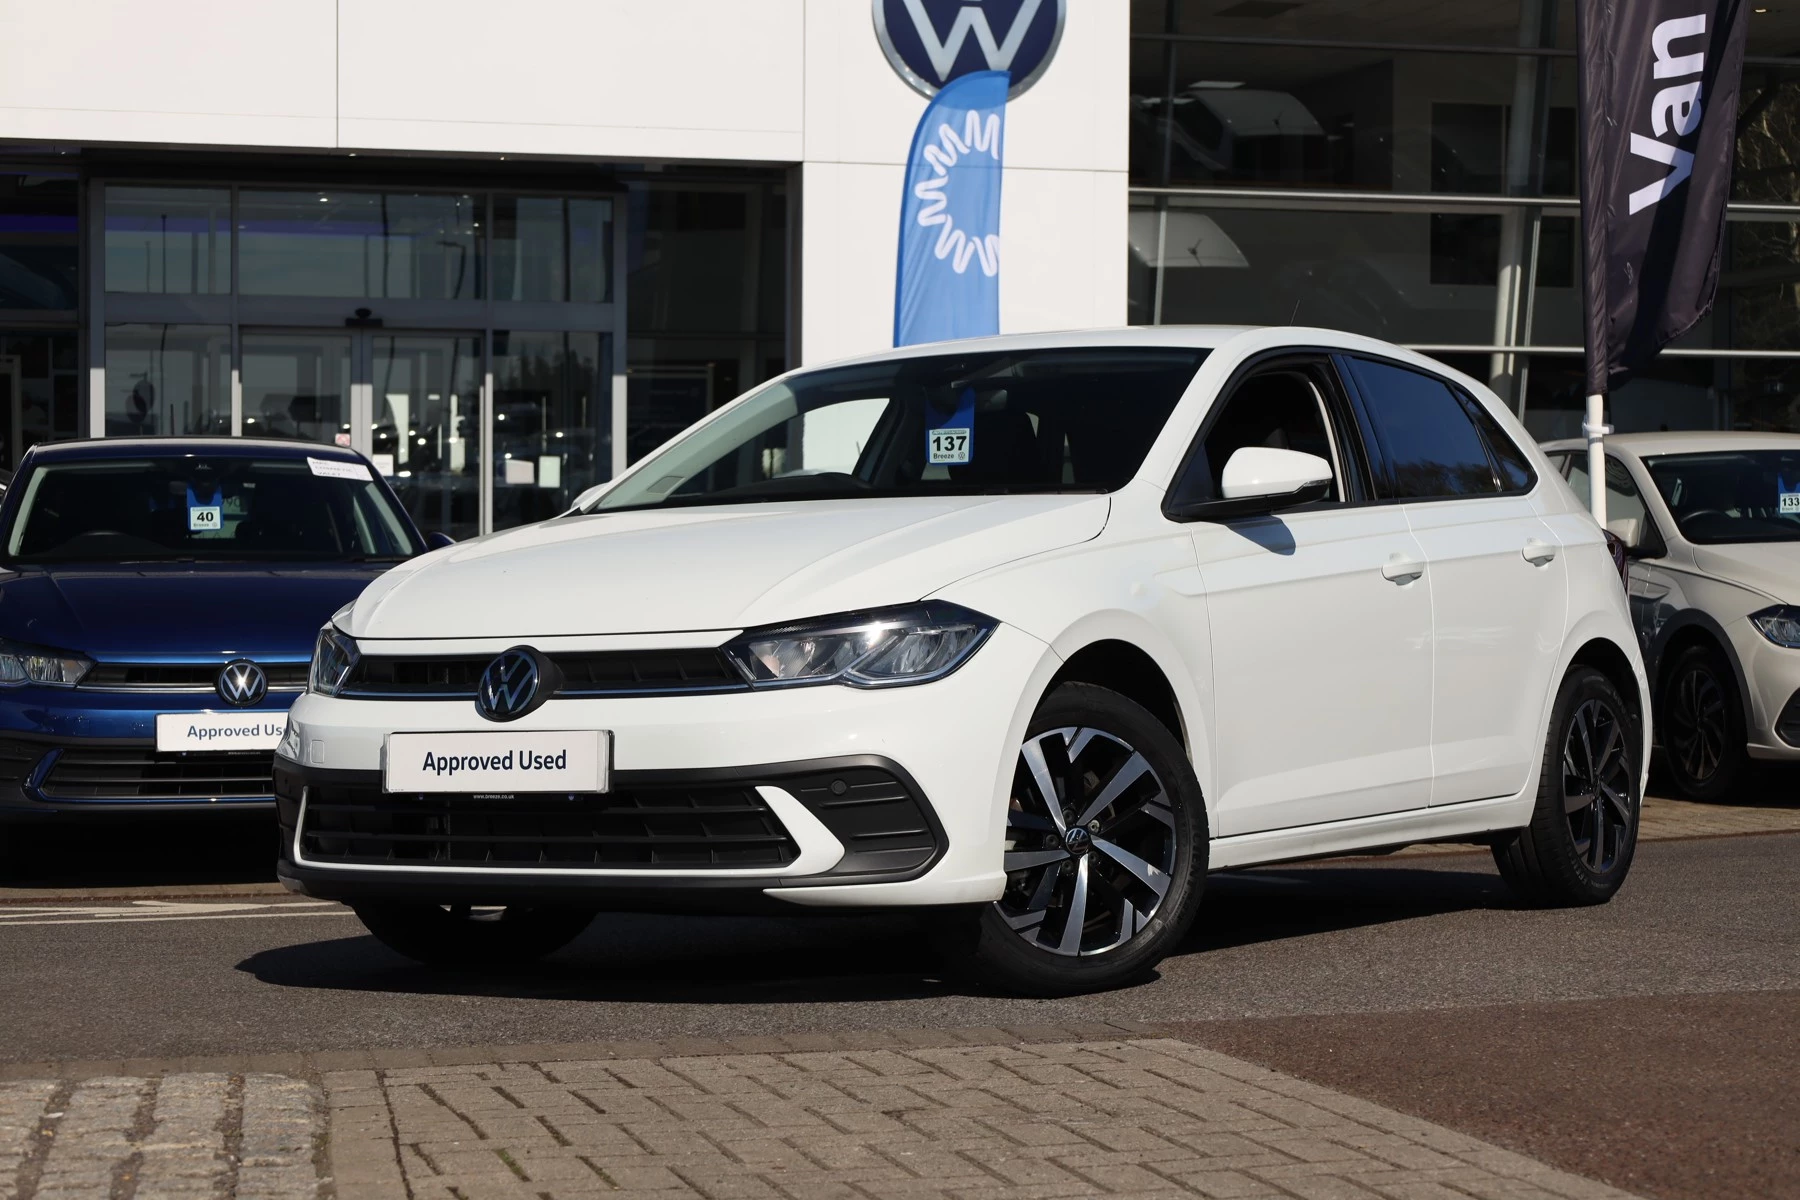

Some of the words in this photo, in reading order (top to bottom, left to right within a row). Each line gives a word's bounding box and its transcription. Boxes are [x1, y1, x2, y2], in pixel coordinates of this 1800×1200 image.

[1629, 13, 1706, 216] Van
[932, 436, 967, 451] 137
[1782, 497, 1799, 507] 133
[196, 511, 214, 522] 40
[187, 724, 260, 741] Approved
[422, 750, 513, 776] Approved
[519, 749, 567, 770] Used
